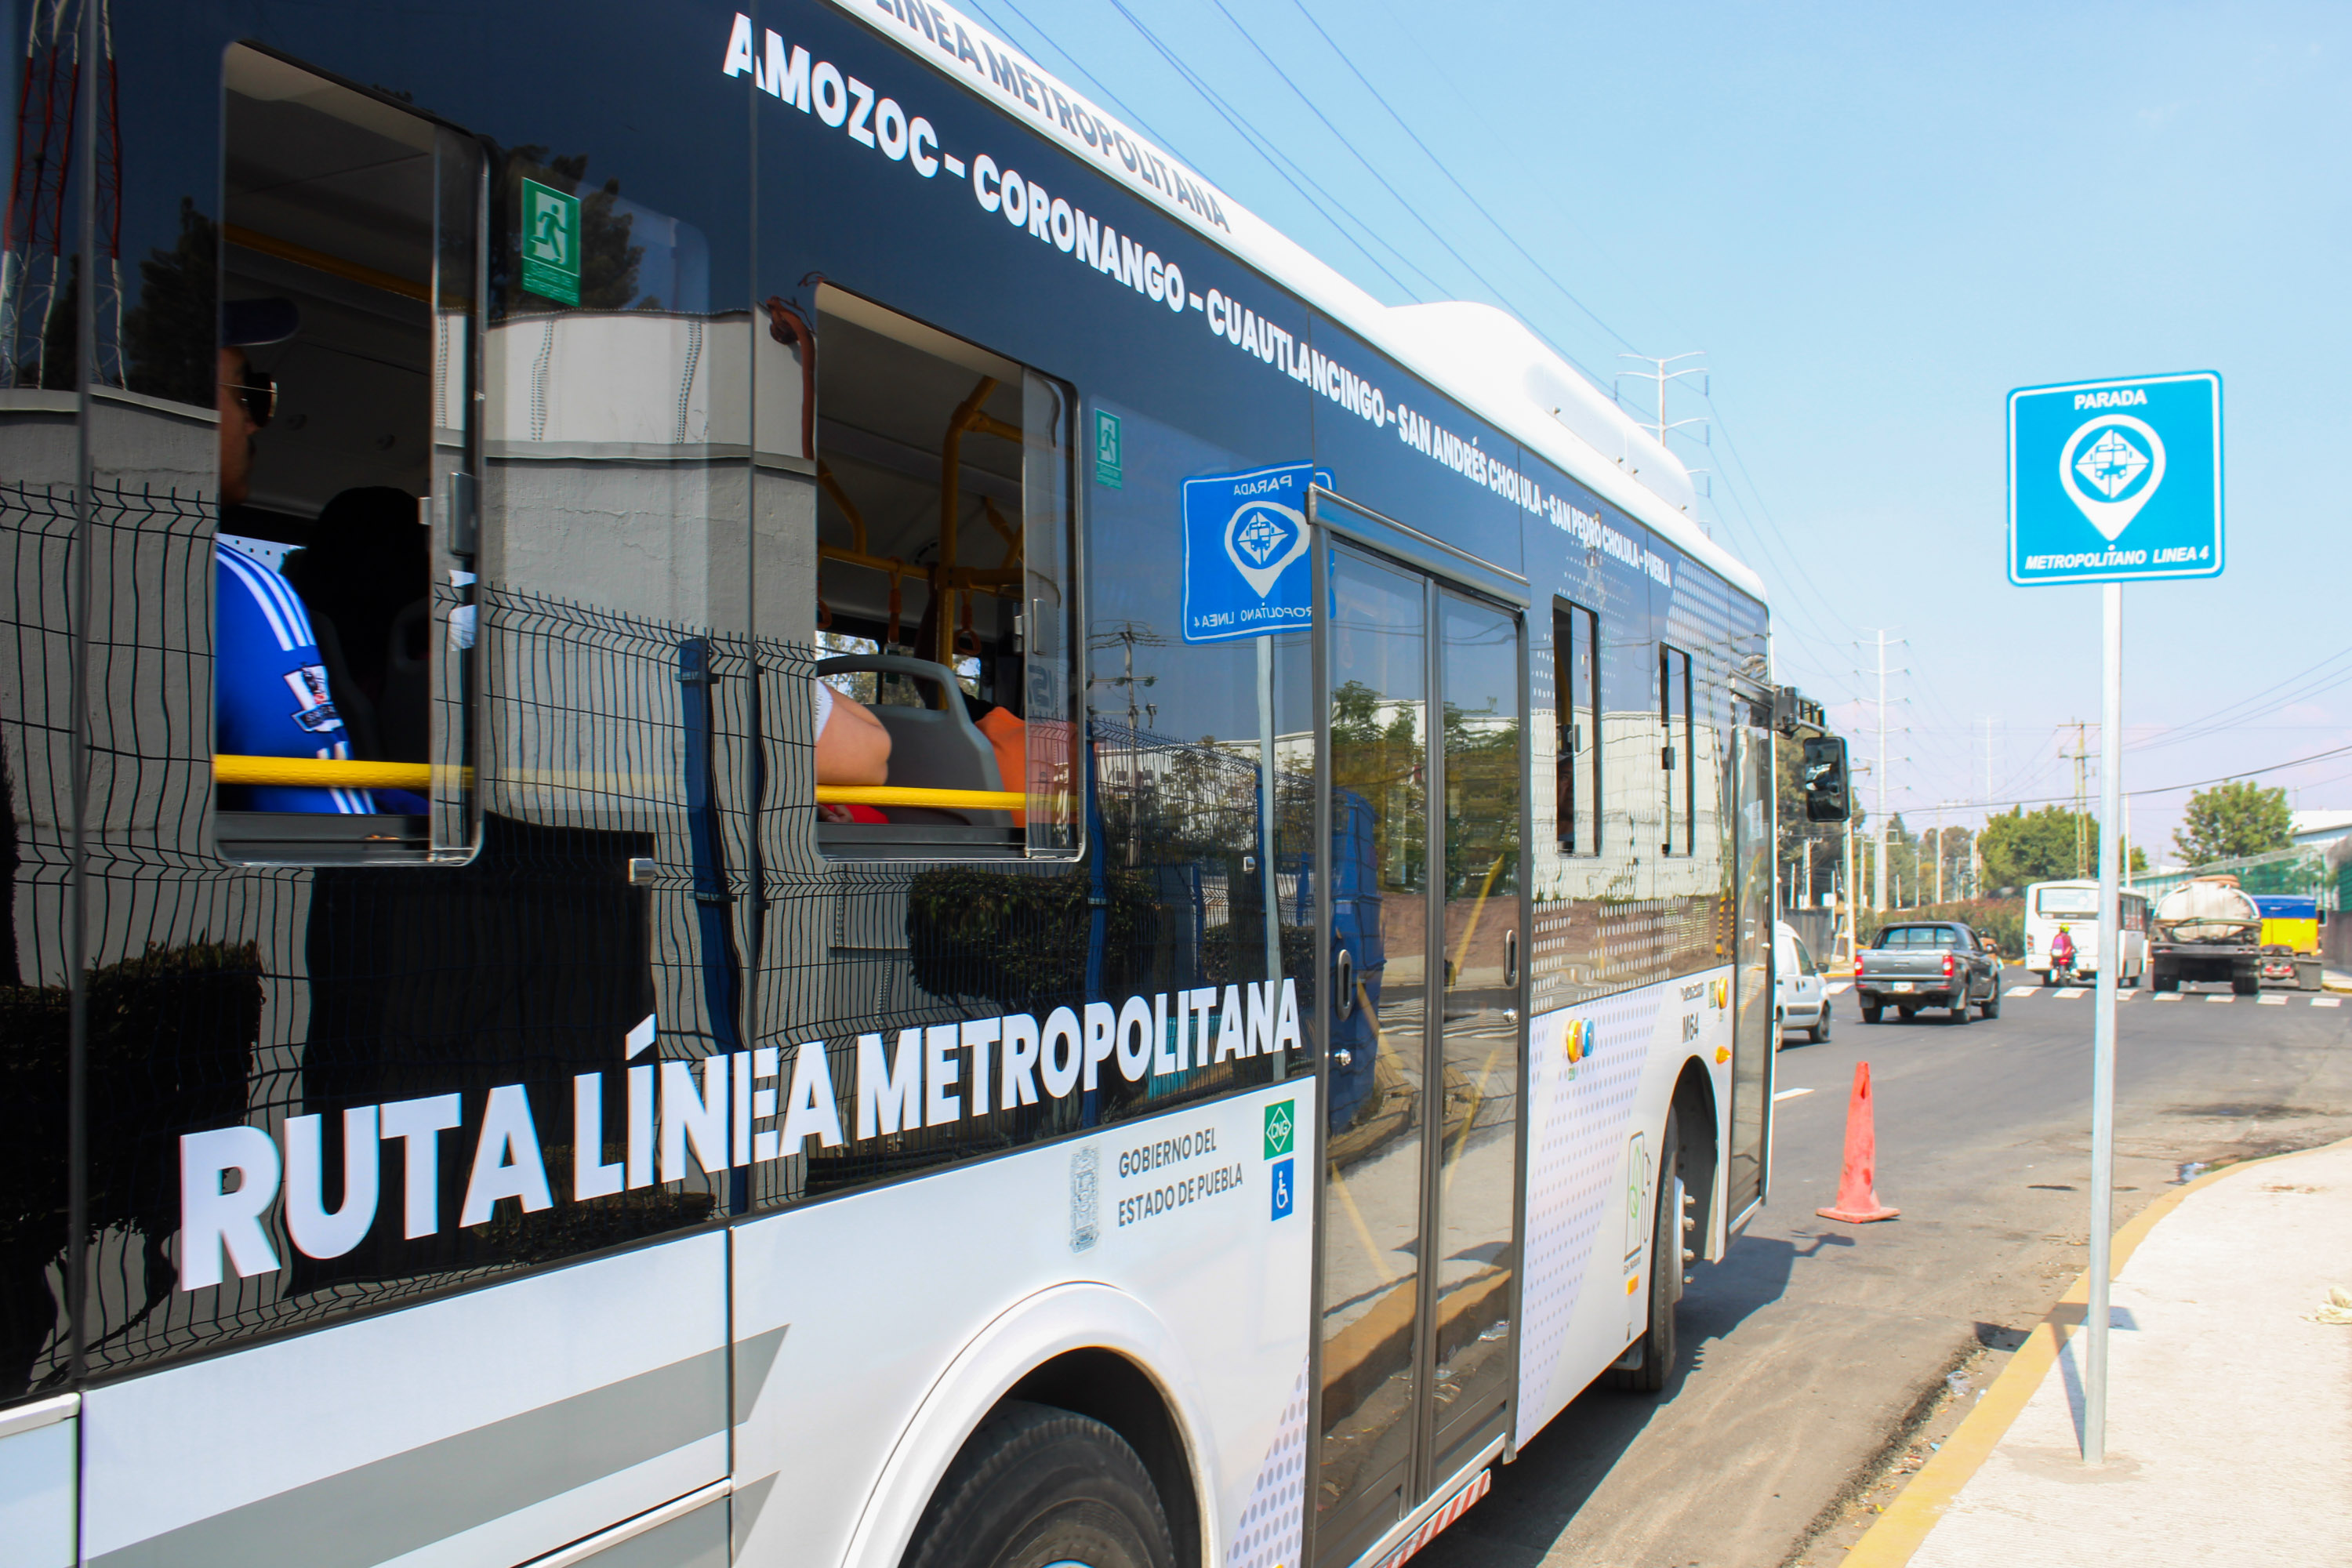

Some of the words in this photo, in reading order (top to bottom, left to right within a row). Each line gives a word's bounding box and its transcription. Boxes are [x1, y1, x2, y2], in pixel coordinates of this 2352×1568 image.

[980, 40, 1232, 234] METROPOLITANA
[723, 12, 939, 178] AMOZOC
[973, 154, 1185, 313] CORONANGO
[1207, 289, 1385, 428] CUAUTLANCINGO
[1398, 404, 1432, 456] SAN
[1432, 426, 1487, 486] ANDRÉS
[1488, 458, 1543, 517] CHOLULA
[1549, 494, 1572, 533] SAN
[1571, 506, 1602, 549] PEDRO
[1602, 525, 1640, 569] CHOLULA
[1643, 549, 1671, 588] PUEBLA
[2074, 389, 2148, 410] PARADA
[2024, 550, 2147, 570] METROPOLITANO
[2152, 546, 2197, 564] LINEA
[2199, 545, 2209, 560] 4
[1682, 1012, 1699, 1044] M64
[180, 1084, 554, 1292] RUTA
[574, 1014, 844, 1202] LÍNEA
[857, 978, 1302, 1141] METROPOLITANA
[1120, 1134, 1192, 1178] GOBIERNO
[1195, 1127, 1217, 1156] DEL
[1272, 1120, 1290, 1139] CNG
[1119, 1185, 1174, 1227] ESTADO
[1178, 1178, 1194, 1207] DE
[1198, 1163, 1243, 1199] PUEBLA
